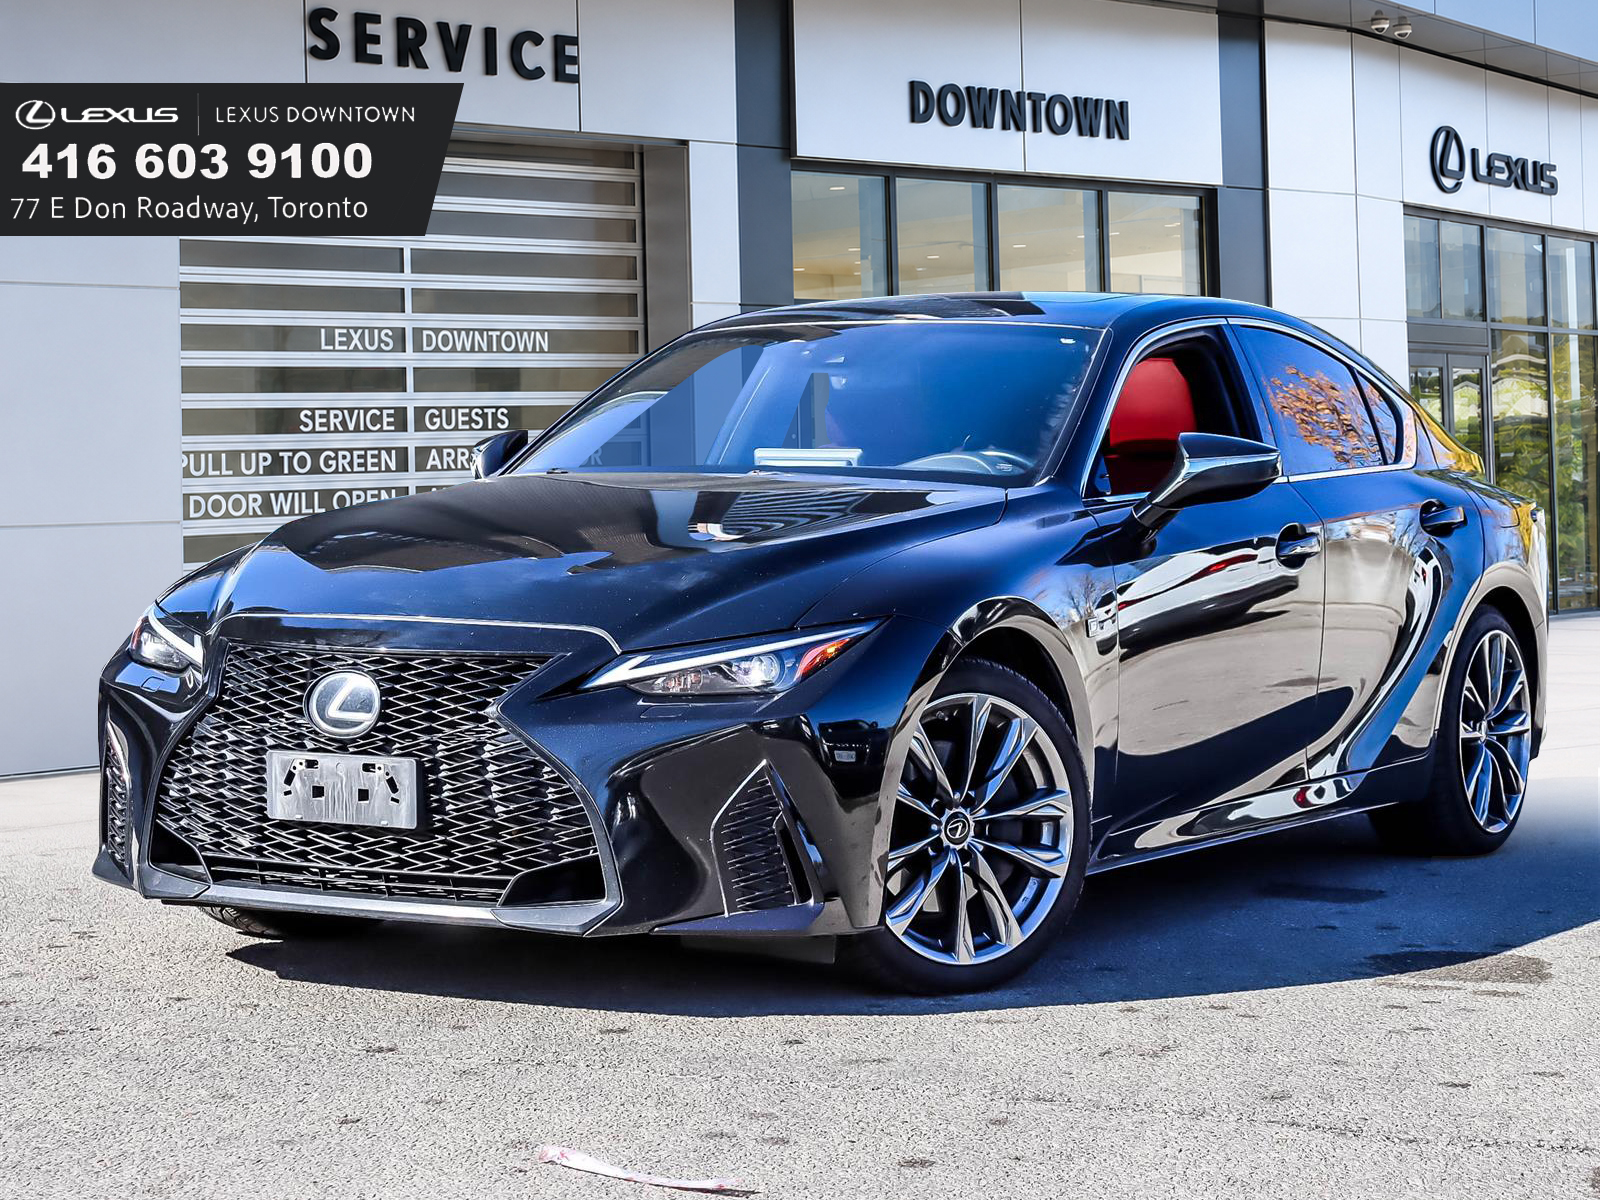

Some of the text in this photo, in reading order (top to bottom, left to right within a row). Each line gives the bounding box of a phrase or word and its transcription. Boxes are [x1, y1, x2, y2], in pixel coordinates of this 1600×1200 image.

[308, 7, 579, 84] SERVICE
[908, 80, 1130, 140] DOWNTOWN
[1470, 147, 1558, 196] LEXUS
[320, 328, 549, 352] LEXUS DOWNTOWN
[299, 408, 509, 432] SERVICE GUESTS
[240, 452, 272, 475] UP
[279, 450, 312, 474] TO
[319, 449, 396, 473] GREEN
[189, 493, 262, 518] DOOR
[269, 491, 326, 515] WILL
